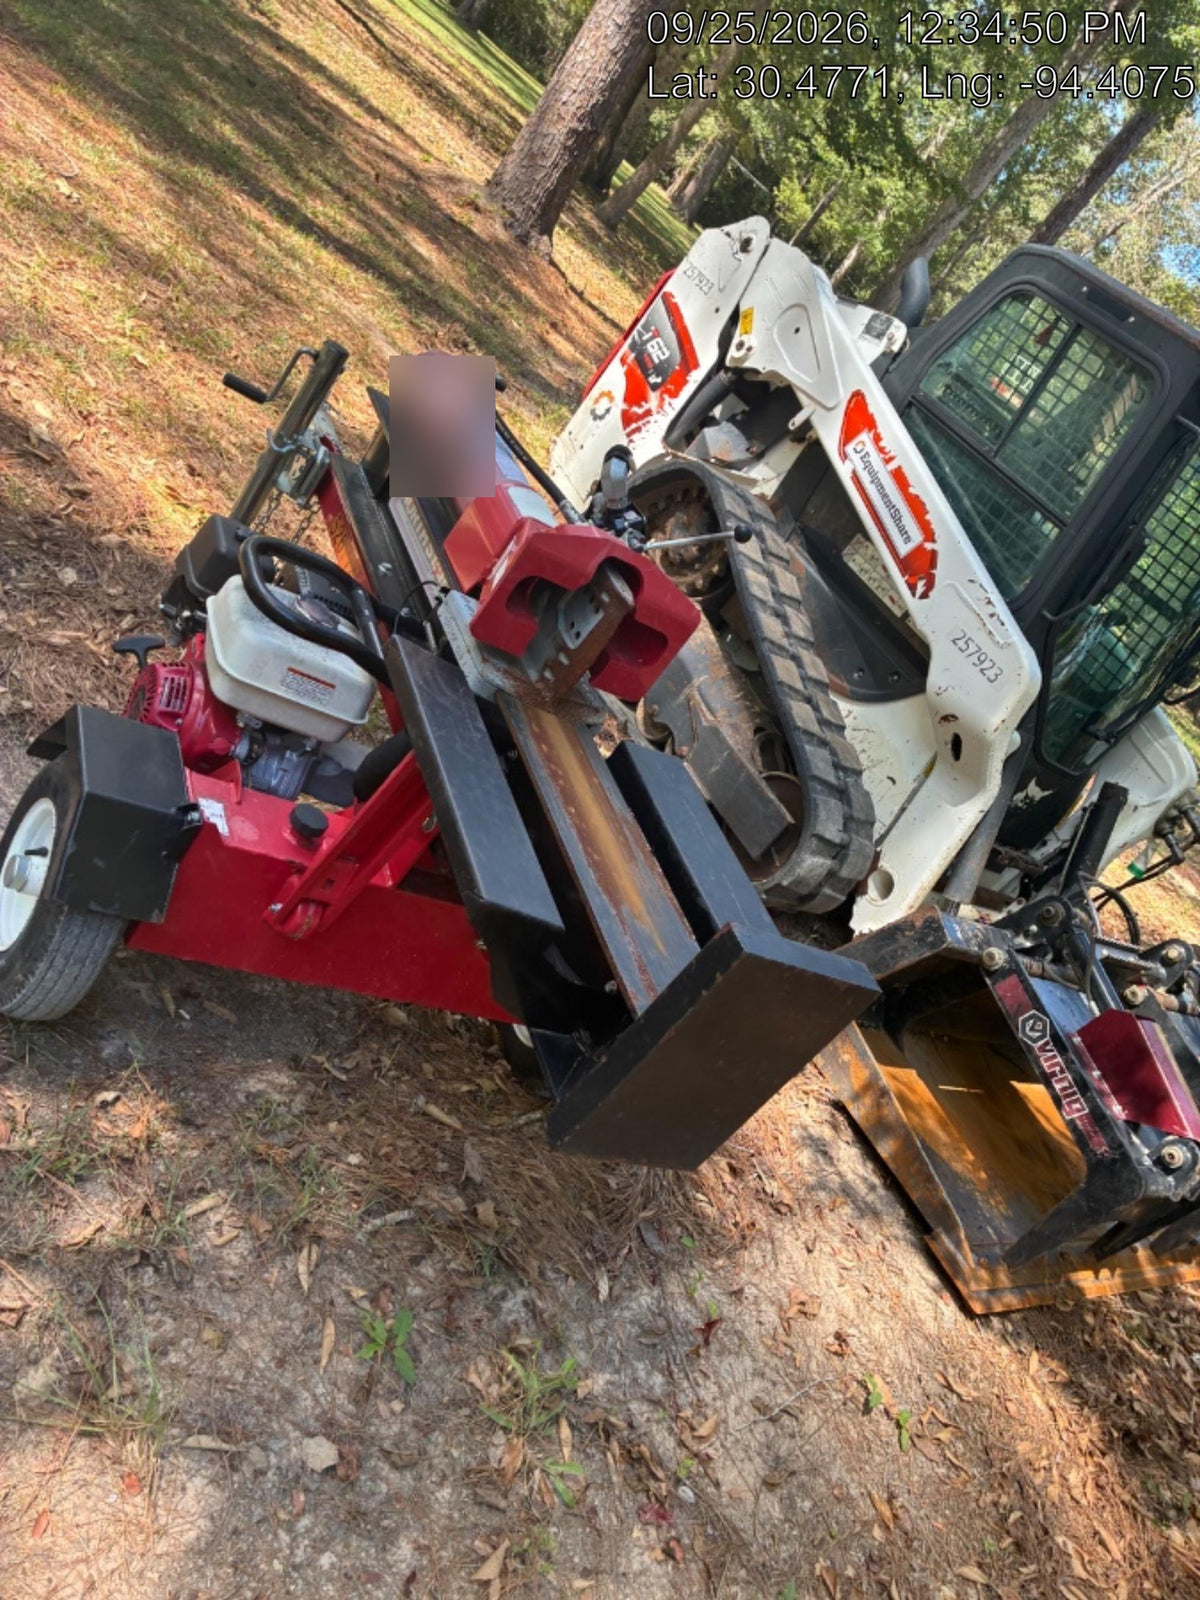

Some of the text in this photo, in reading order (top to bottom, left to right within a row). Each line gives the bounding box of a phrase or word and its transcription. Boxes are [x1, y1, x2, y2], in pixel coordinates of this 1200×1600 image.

[682, 262, 714, 296] 257923
[860, 451, 912, 544] EquipmentShare
[951, 628, 1003, 684] 257923
